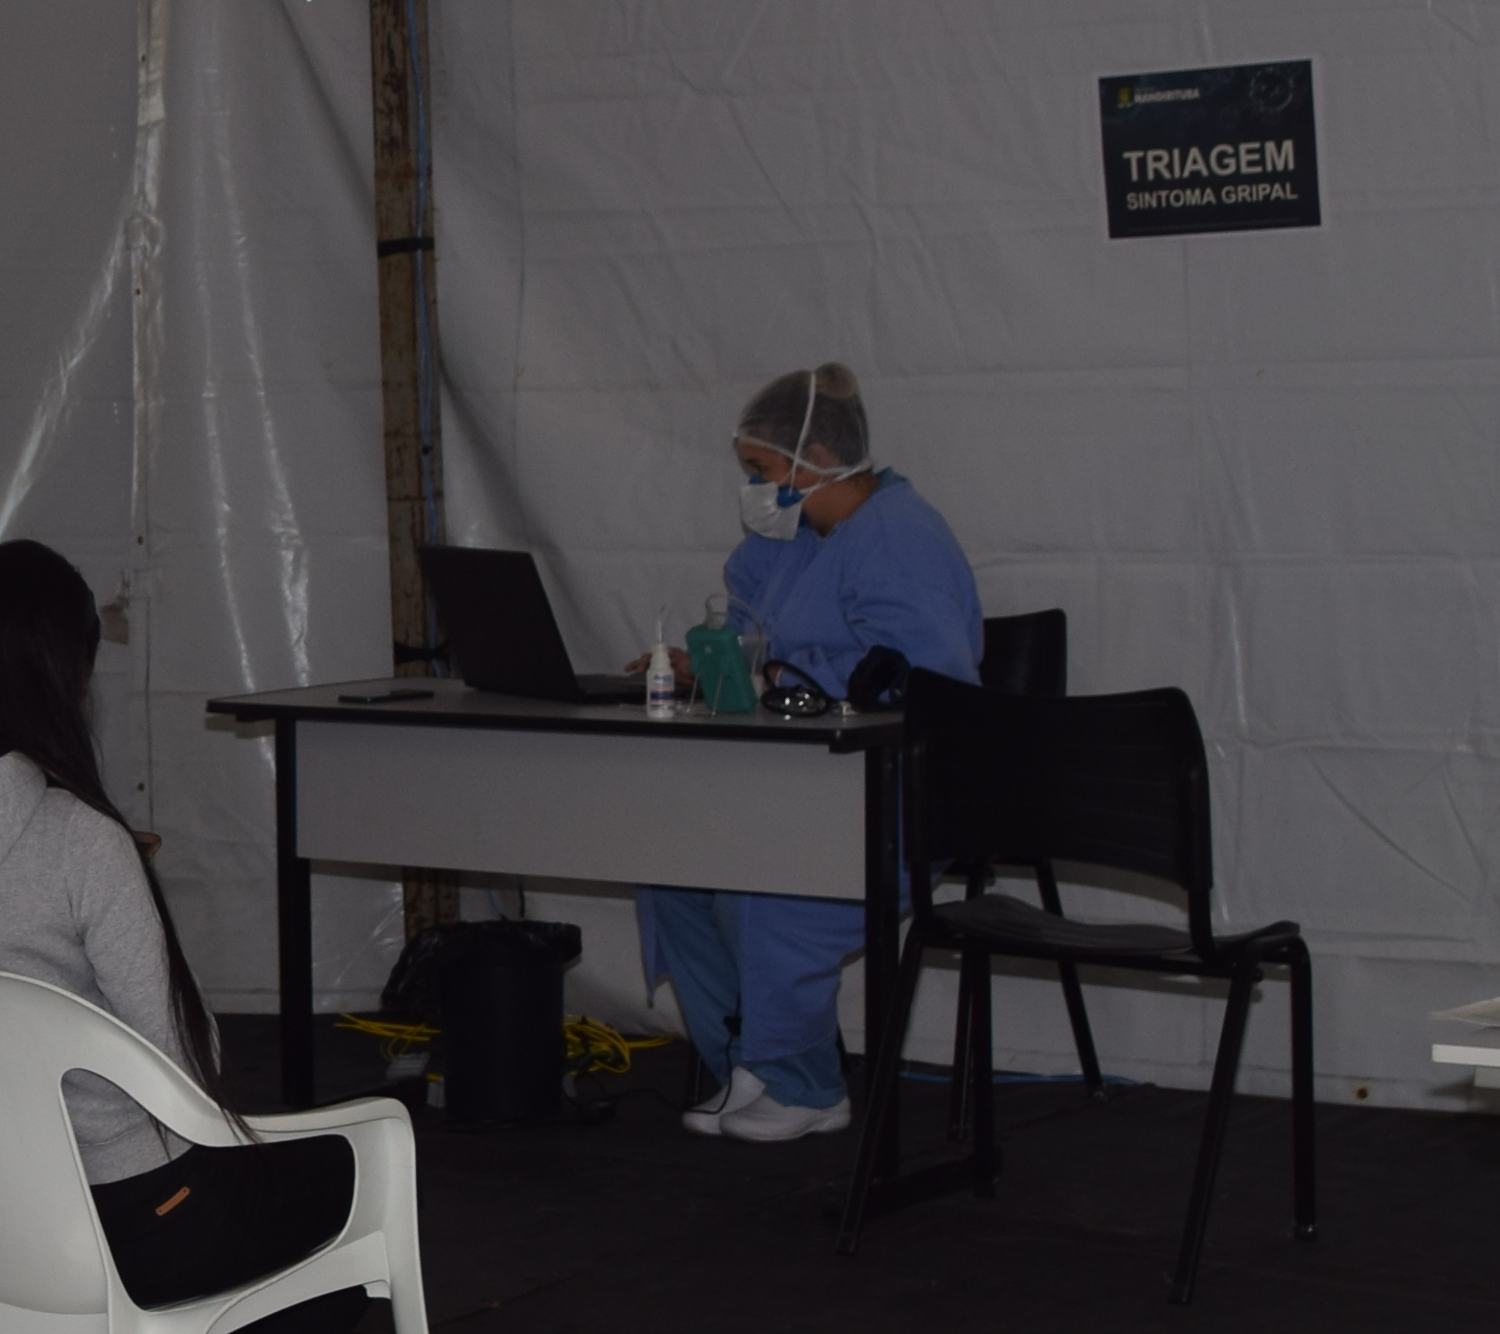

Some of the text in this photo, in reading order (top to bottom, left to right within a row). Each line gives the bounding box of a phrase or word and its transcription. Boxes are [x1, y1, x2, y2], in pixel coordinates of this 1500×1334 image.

[1123, 139, 1295, 182] TRIAGEM
[1126, 182, 1298, 211] SINTOMA GRIPAL
